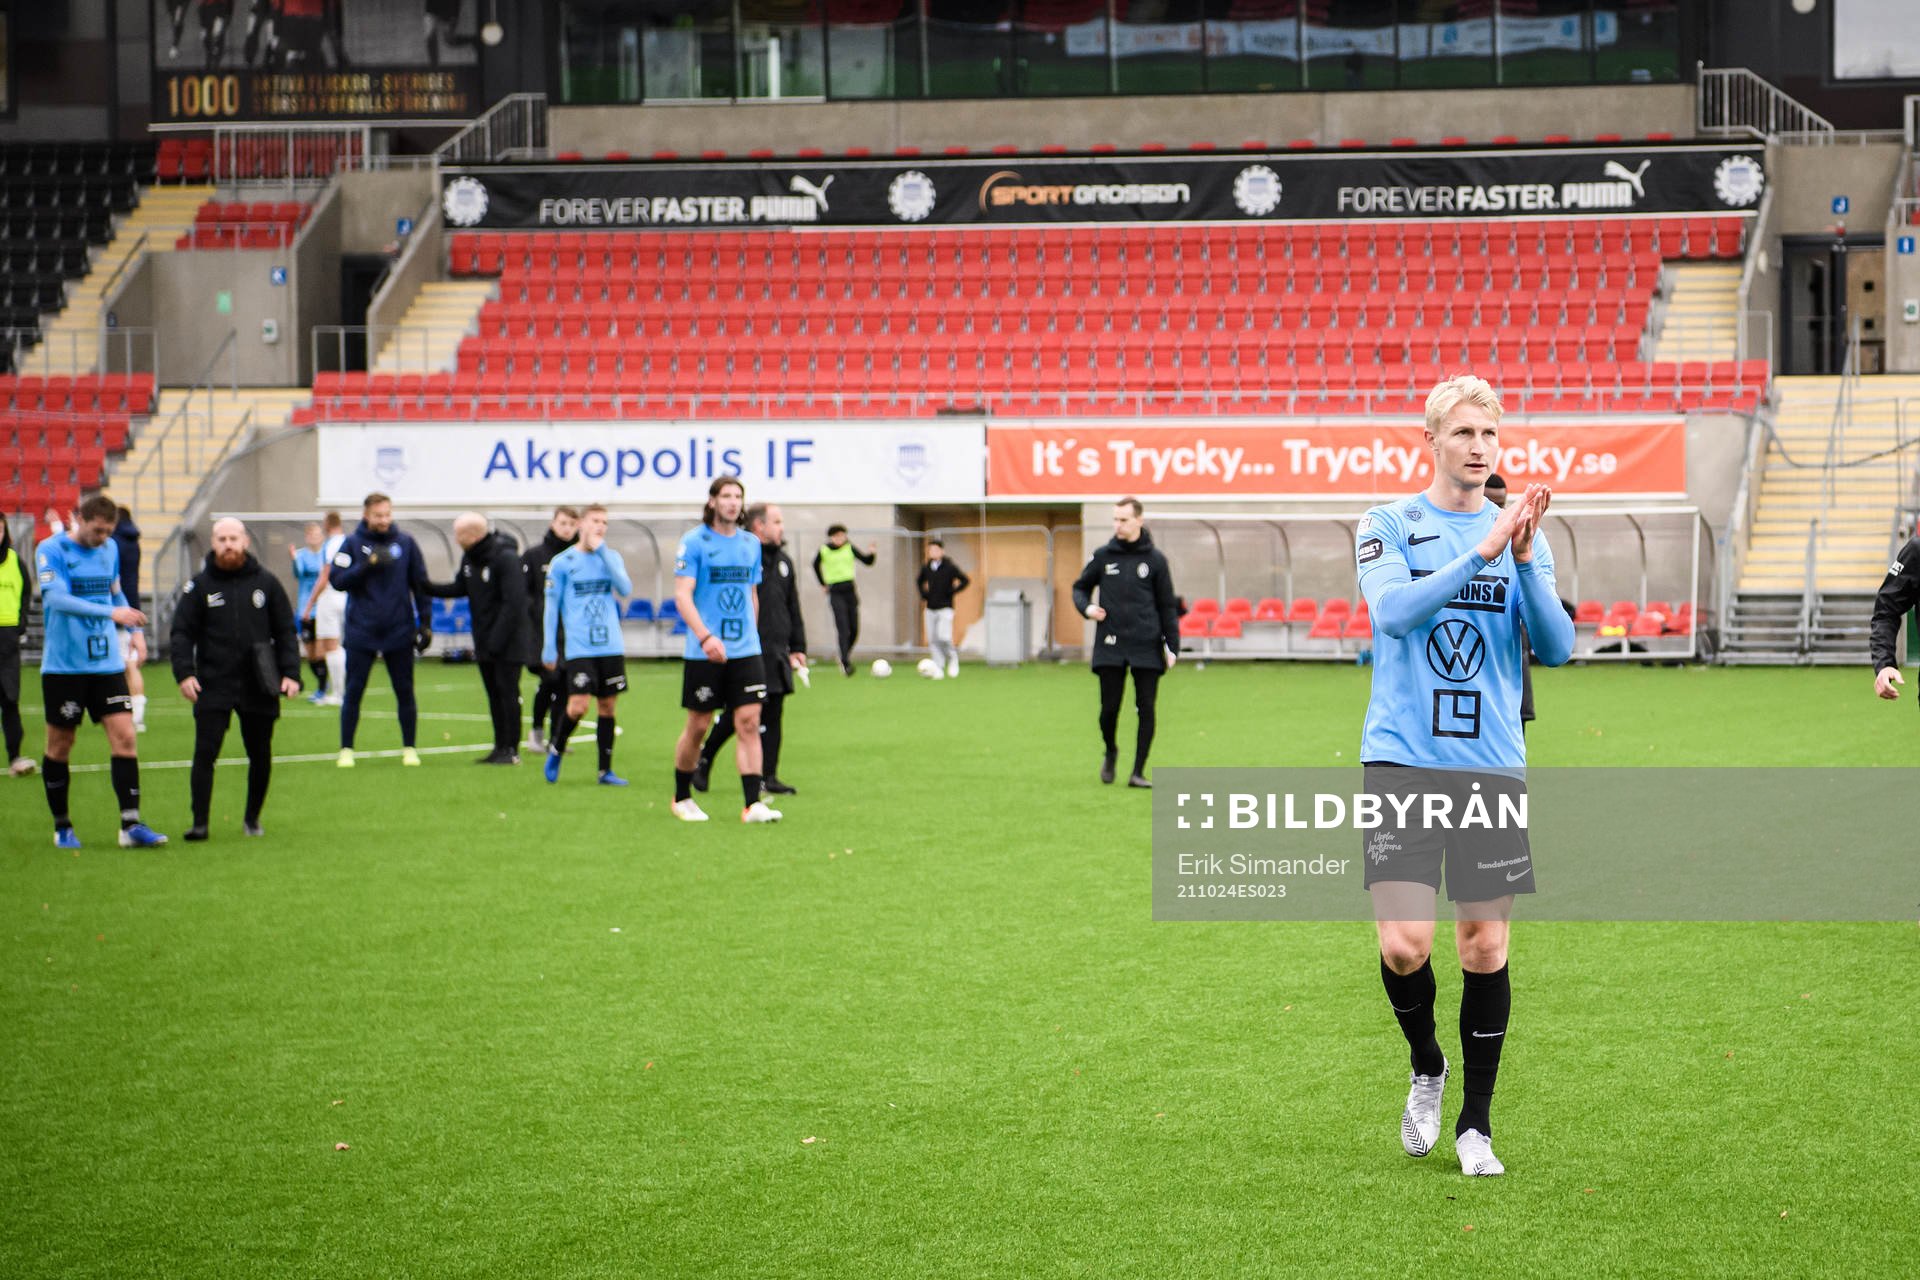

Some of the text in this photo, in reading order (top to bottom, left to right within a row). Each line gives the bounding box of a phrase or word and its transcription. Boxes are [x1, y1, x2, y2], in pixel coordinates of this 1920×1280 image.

[168, 75, 239, 117] 1000
[1561, 182, 1633, 208] PUMA
[484, 438, 814, 486] Akropolis IF
[1107, 439, 1275, 483] Trycky...
[1283, 439, 1429, 483] Trycky,
